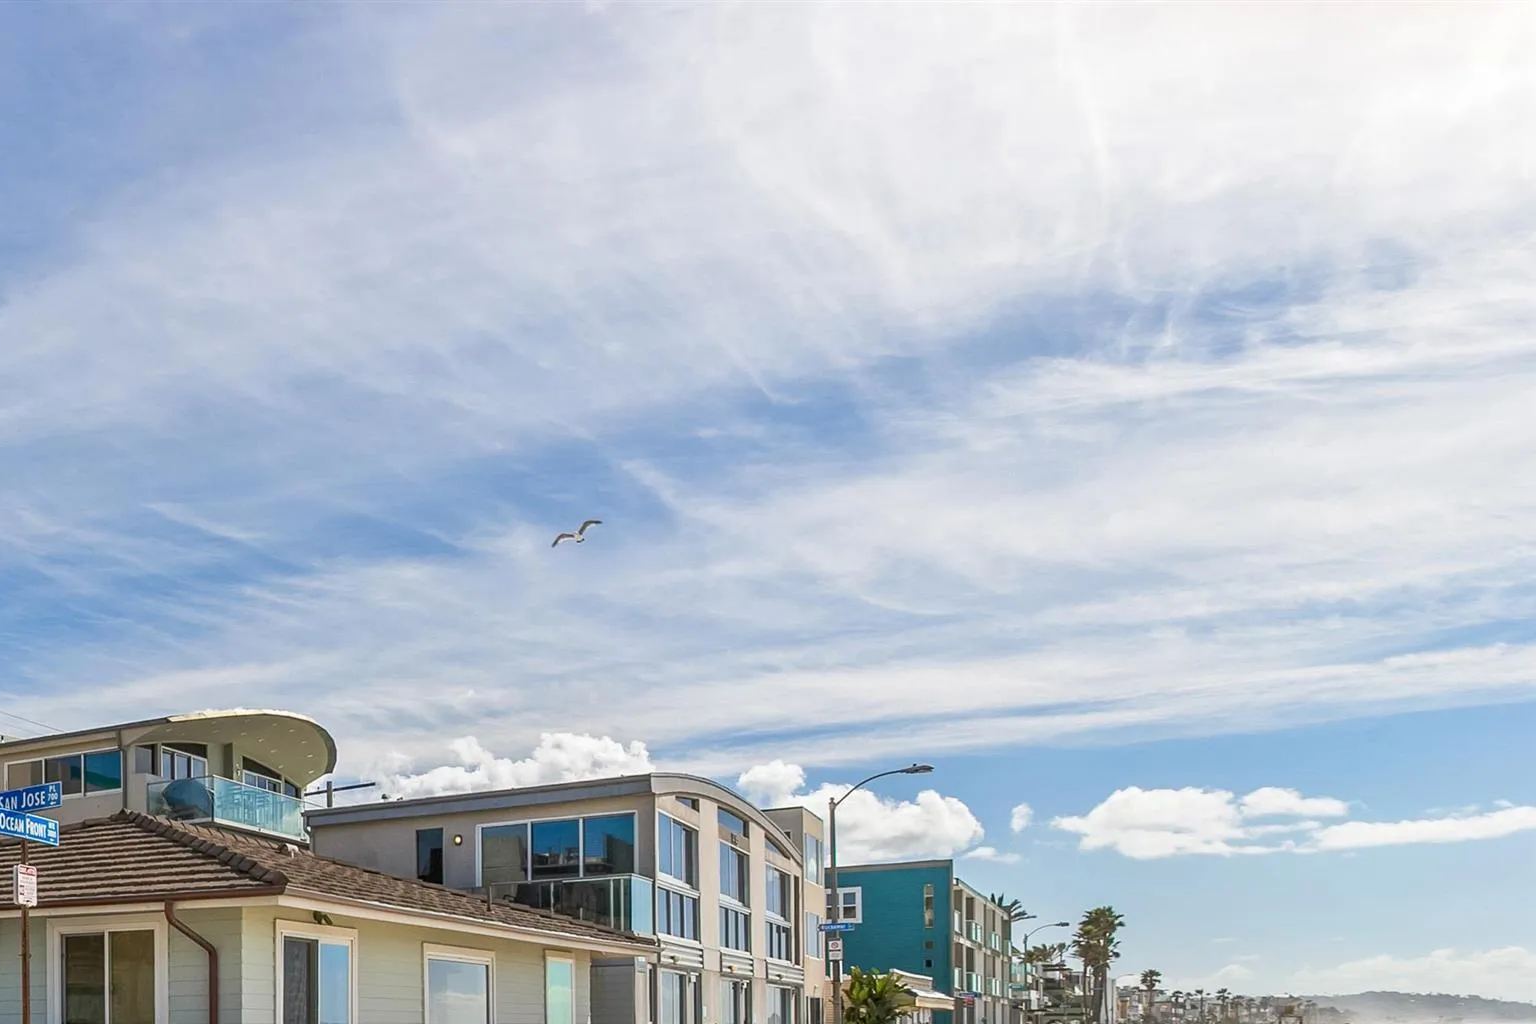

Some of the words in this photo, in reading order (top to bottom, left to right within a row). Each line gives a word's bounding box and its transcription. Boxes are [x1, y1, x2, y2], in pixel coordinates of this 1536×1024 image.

[21, 791, 46, 808] JOSE
[0, 812, 24, 833] OCEAN
[26, 818, 47, 838] FRONT
